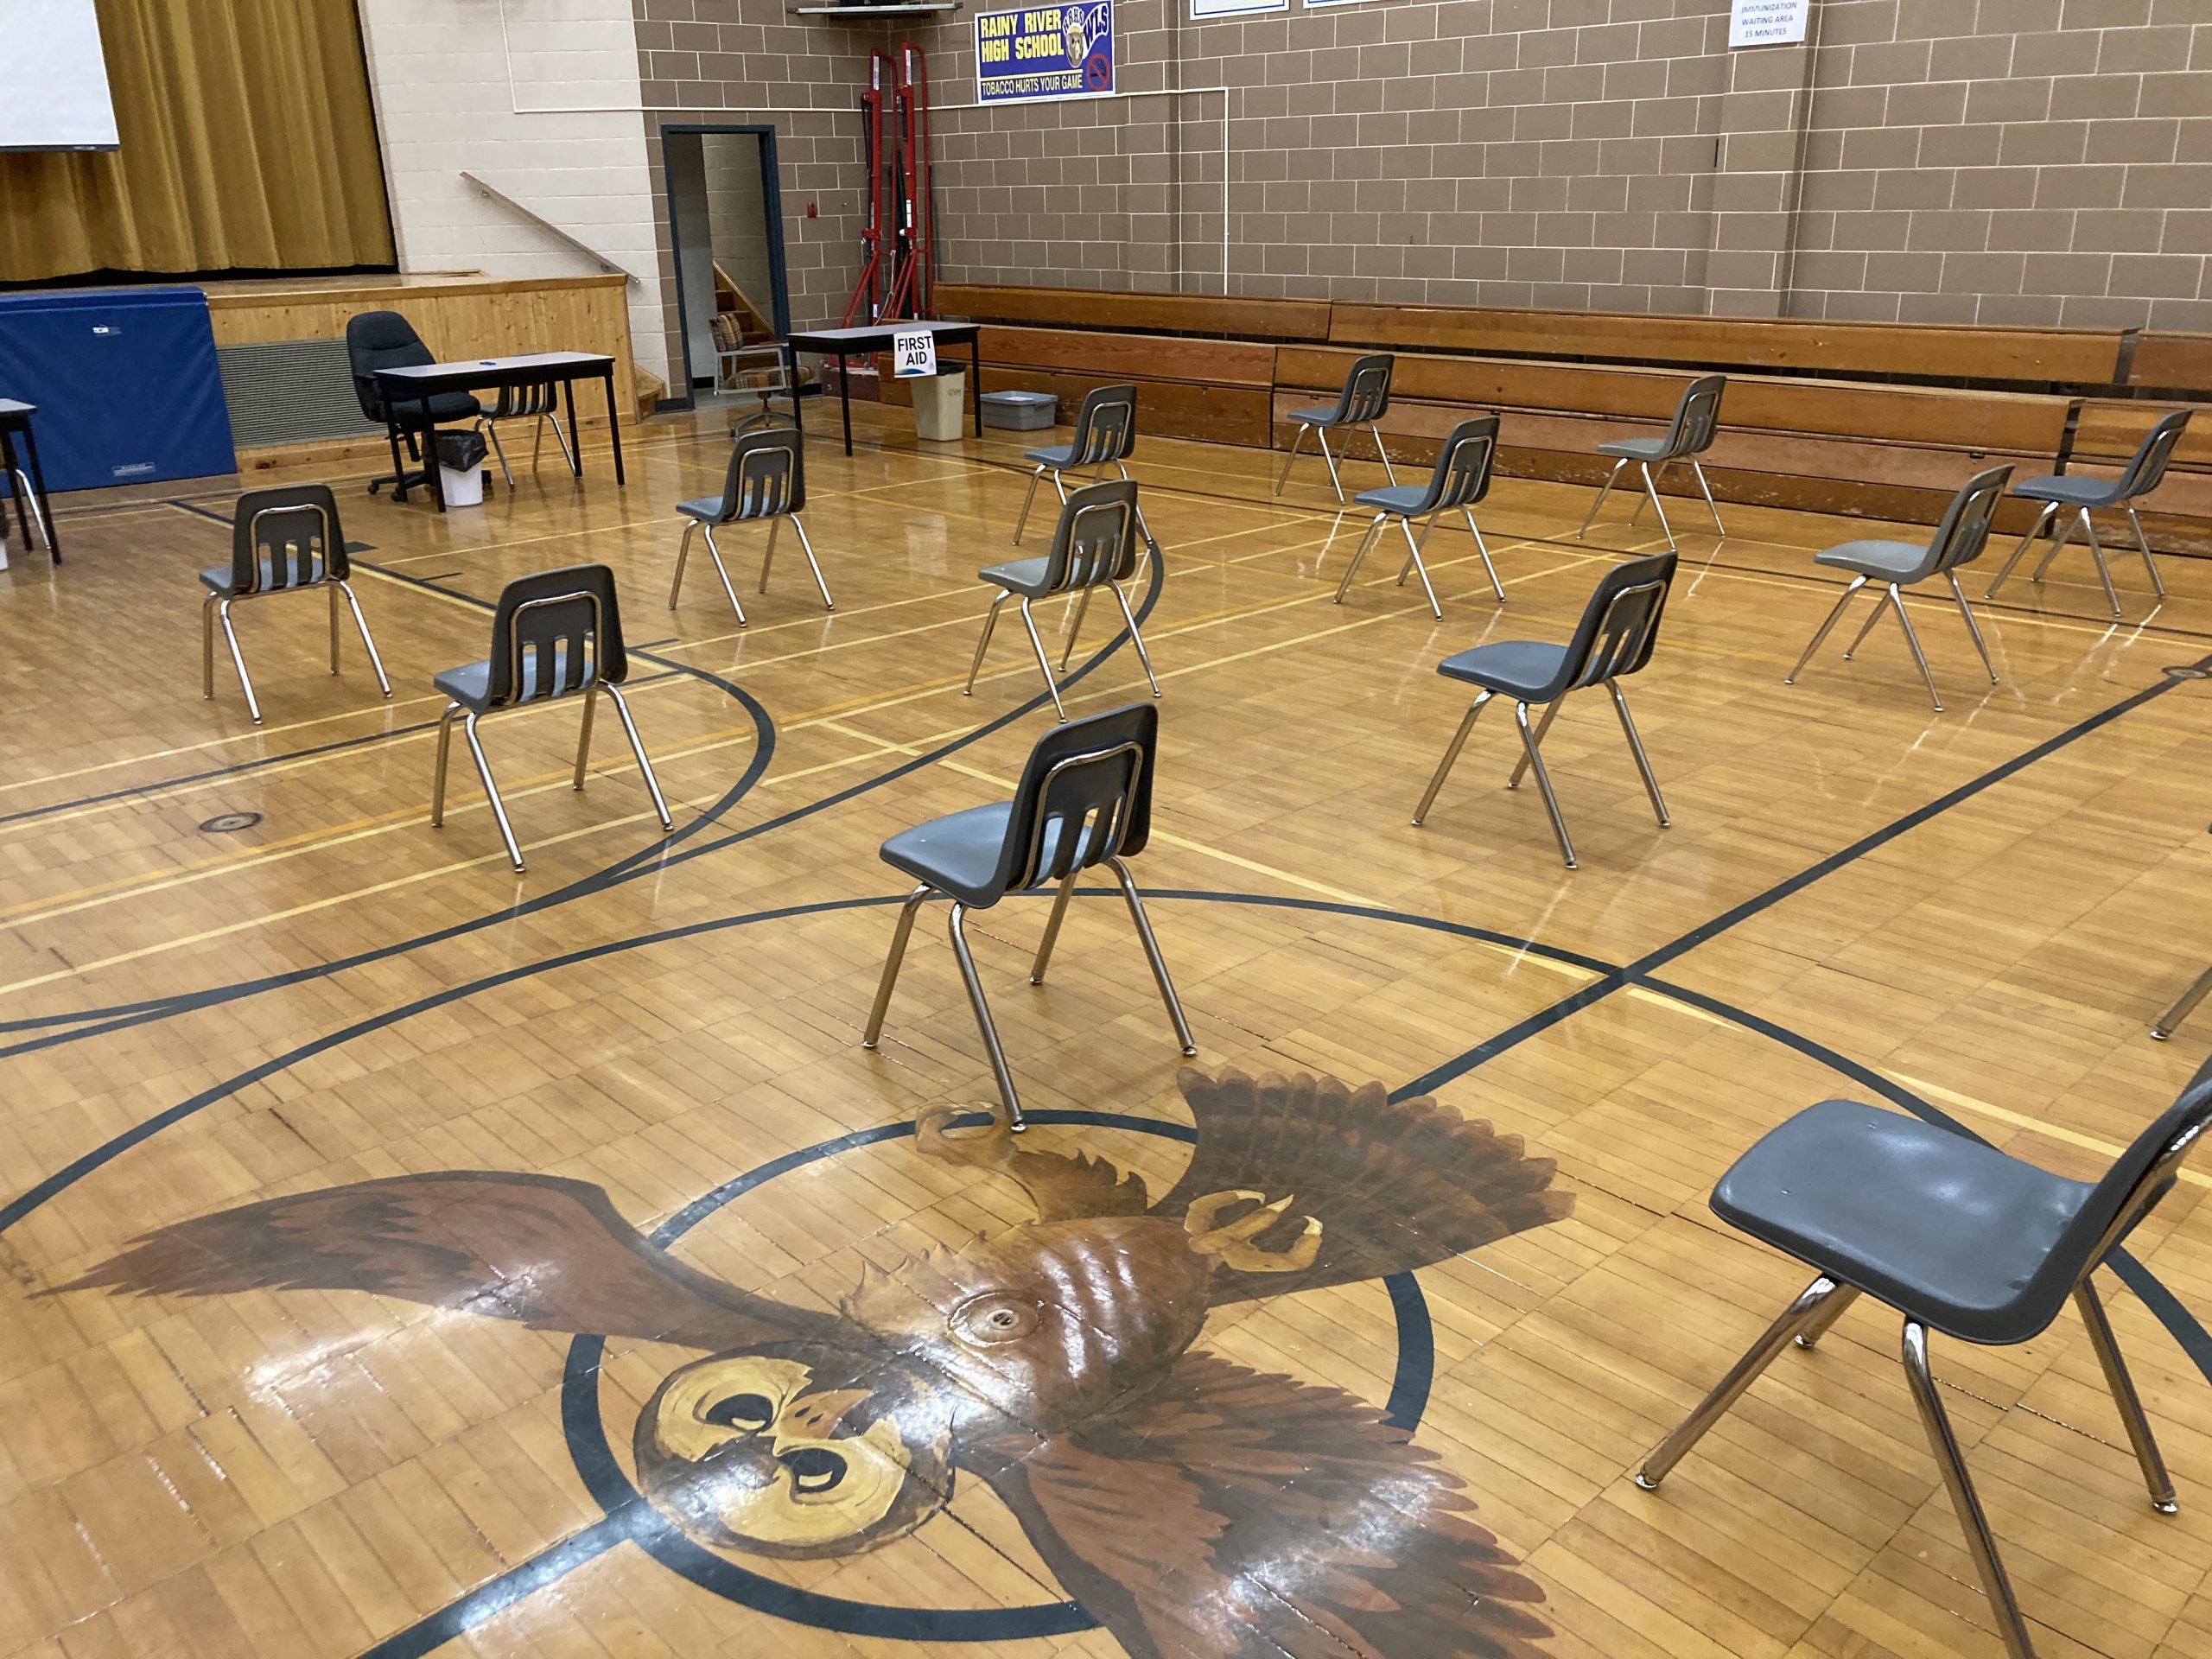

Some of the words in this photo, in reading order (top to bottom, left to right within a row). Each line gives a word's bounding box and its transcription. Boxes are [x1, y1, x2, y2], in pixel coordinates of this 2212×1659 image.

[1741, 2, 1797, 13] IMMUNIZATION
[981, 14, 1019, 38] RAINY
[1024, 9, 1062, 34] RIVER
[1742, 16, 1774, 25] WAITING
[1754, 28, 1787, 37] MINUTES
[981, 38, 1010, 63] HIGH
[1014, 33, 1065, 60] SCHOOL
[982, 79, 1014, 96] TOBACCO
[1015, 77, 1039, 93] HURTS
[1040, 75, 1061, 92] YOUR
[1062, 73, 1084, 90] GAME
[897, 335, 932, 353] FIRST
[906, 351, 928, 366] AID
